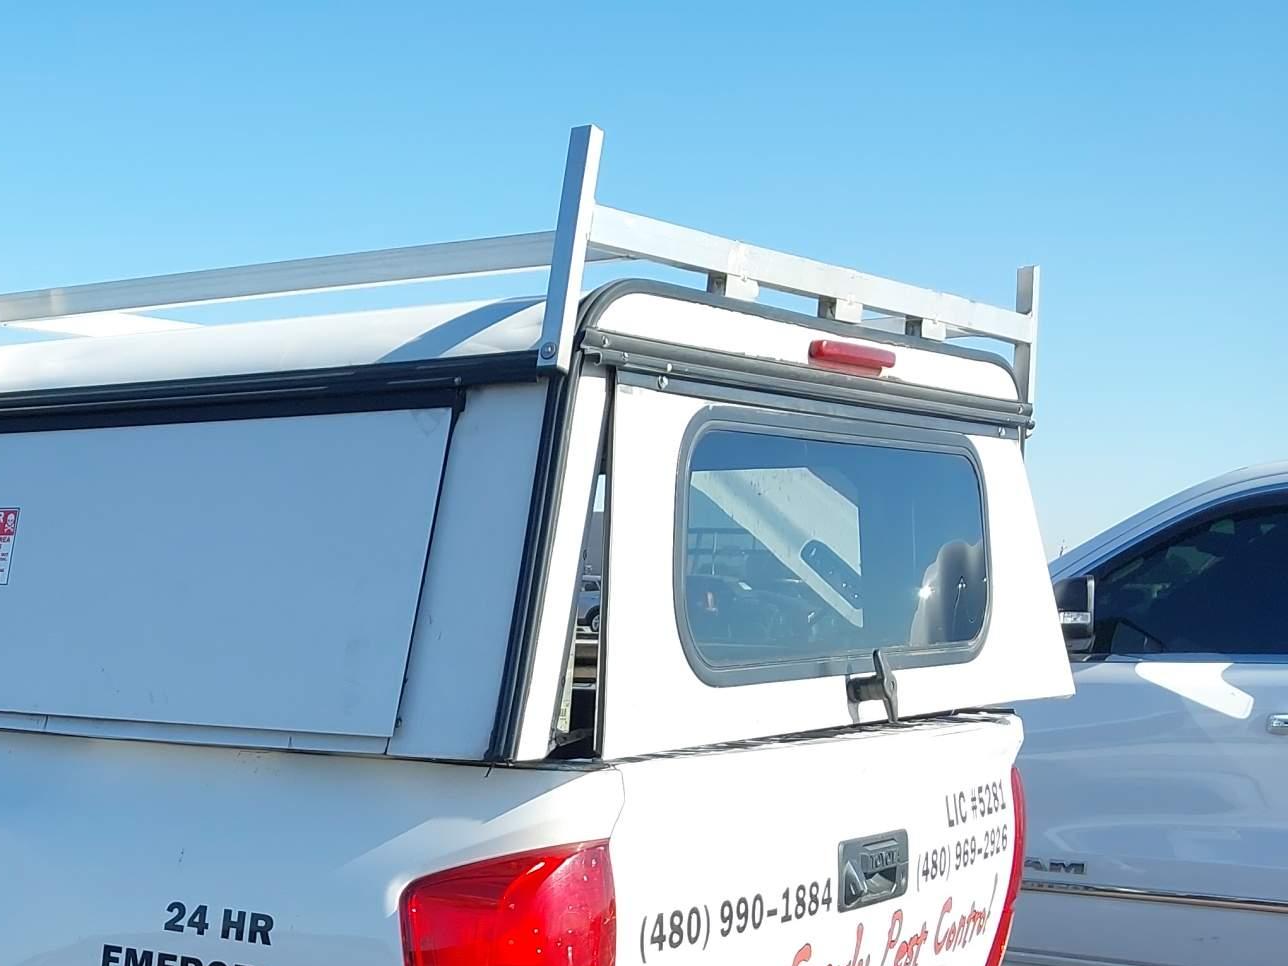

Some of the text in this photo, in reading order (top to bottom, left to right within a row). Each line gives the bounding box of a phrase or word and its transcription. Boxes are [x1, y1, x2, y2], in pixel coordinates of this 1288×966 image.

[945, 779, 1006, 827] LIC #5281
[916, 824, 1008, 892] (480) 969-2926
[1023, 857, 1087, 876] AM
[164, 901, 274, 946] 24 HR
[640, 877, 833, 964] (480) 990-1884
[934, 872, 999, 956] Control
